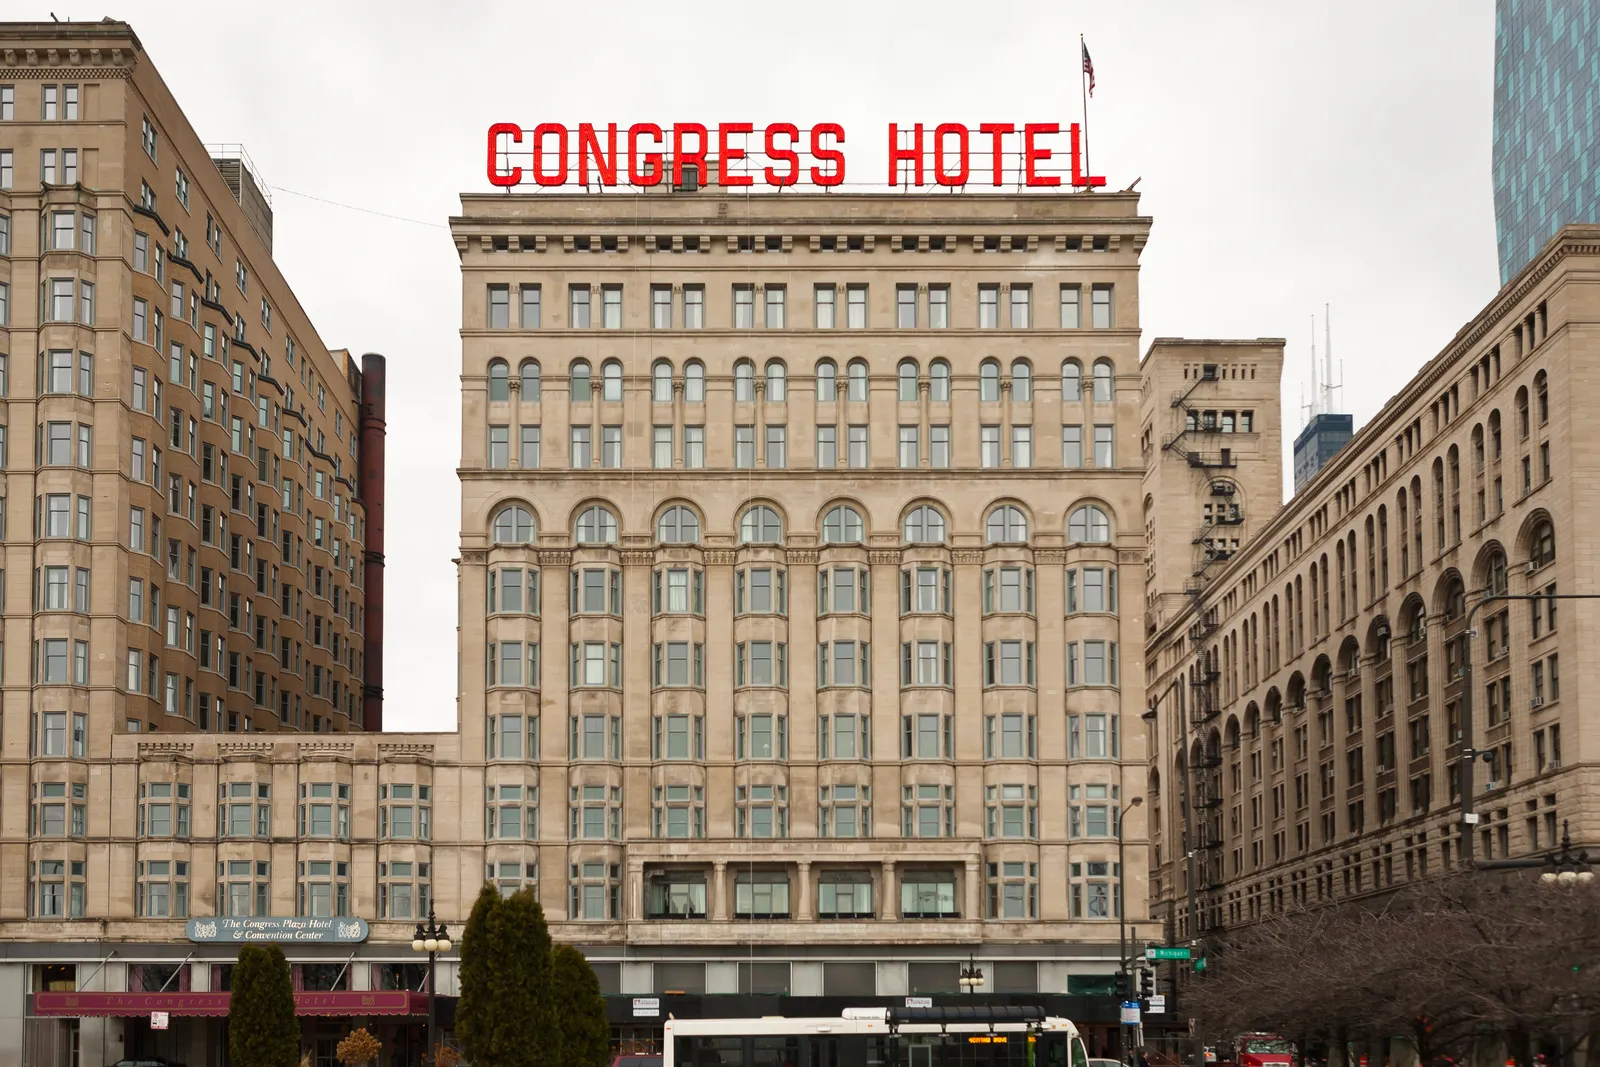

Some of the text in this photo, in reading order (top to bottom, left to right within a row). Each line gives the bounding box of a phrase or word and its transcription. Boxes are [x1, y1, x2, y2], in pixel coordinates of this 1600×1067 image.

[486, 122, 1106, 187] CONGRESS HOTEL
[222, 919, 333, 930] The Congress Plaza Hotel
[233, 930, 324, 940] & Convention Center
[1159, 949, 1183, 957] Michigan
[105, 996, 133, 1005] The
[144, 996, 223, 1008] Congress
